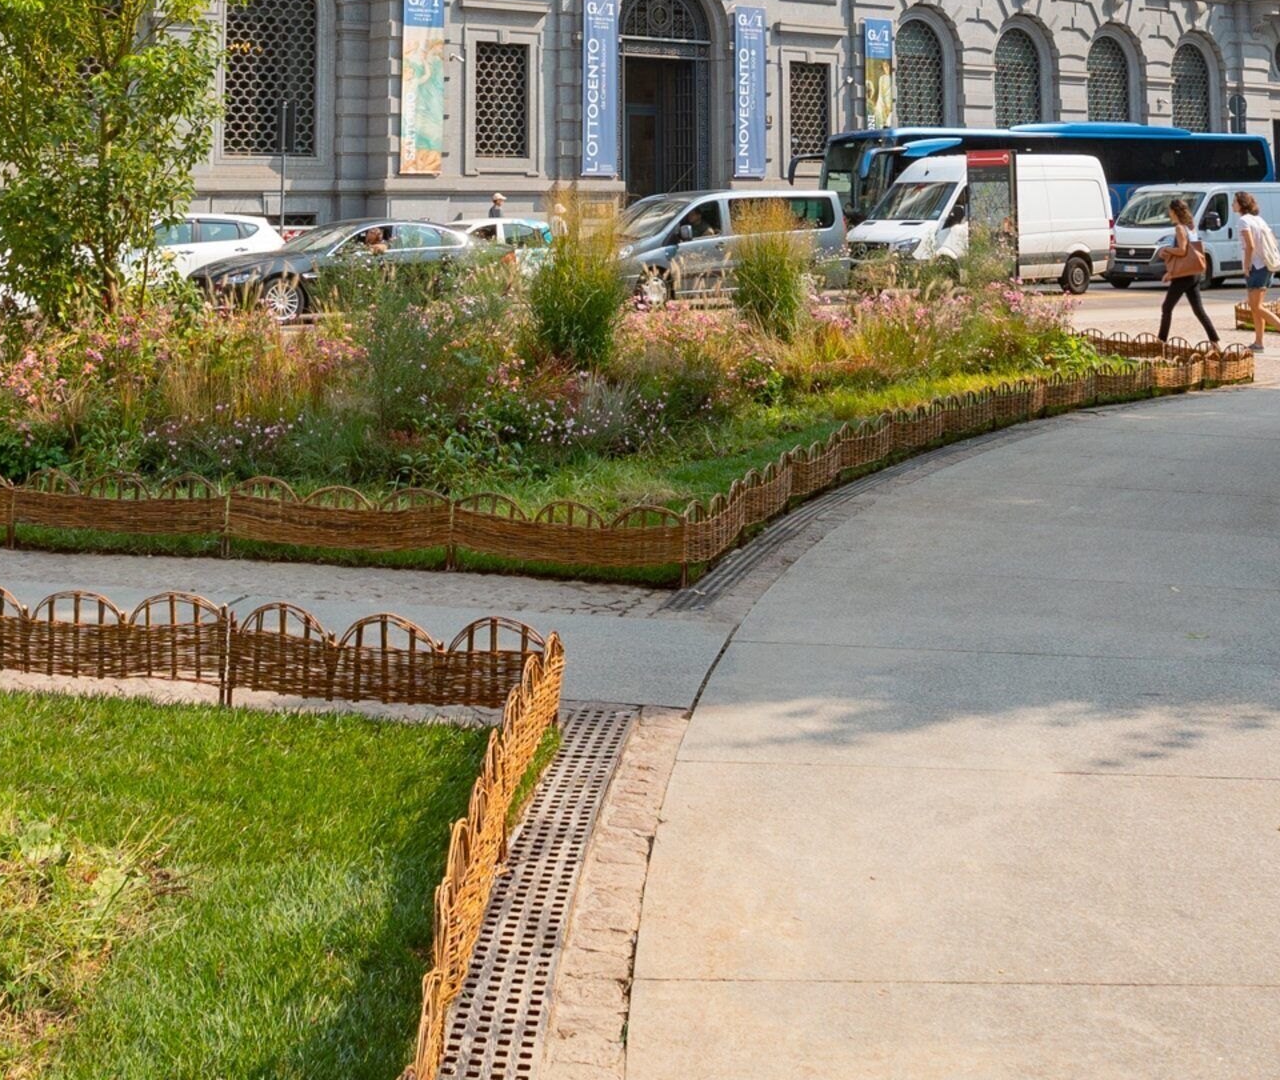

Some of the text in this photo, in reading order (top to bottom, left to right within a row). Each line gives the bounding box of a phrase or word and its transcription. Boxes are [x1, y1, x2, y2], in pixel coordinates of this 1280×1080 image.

[405, 92, 416, 160] SARTORIO
[586, 38, 600, 171] L'OTTOCENTO
[738, 48, 750, 173] IL NOVECENTO
